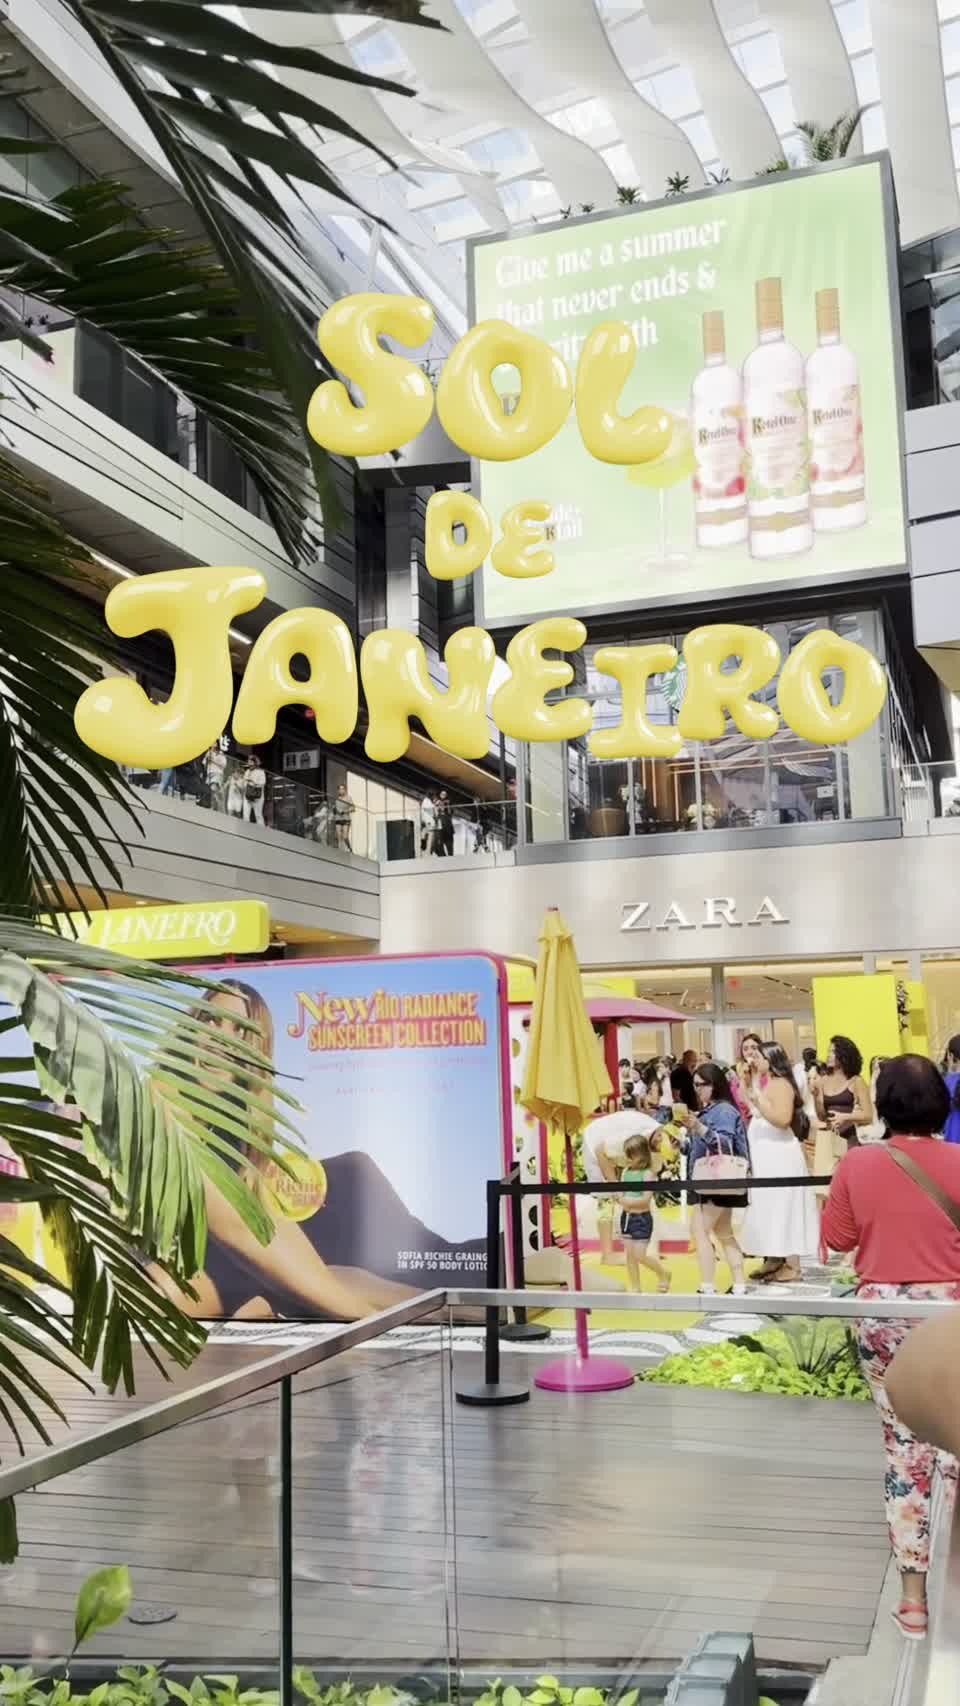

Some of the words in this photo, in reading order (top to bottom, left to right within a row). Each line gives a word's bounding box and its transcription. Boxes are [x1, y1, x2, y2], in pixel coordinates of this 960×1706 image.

[495, 255, 549, 287] Give
[556, 247, 593, 276] me
[599, 242, 614, 266] a
[620, 219, 727, 262] summer
[552, 284, 623, 320] never
[630, 265, 689, 303] ends
[696, 261, 717, 289] &
[619, 896, 791, 932] ZARA
[287, 990, 381, 1037] New
[375, 992, 399, 1019] RIO
[406, 992, 478, 1018] RADIANCE
[308, 1022, 394, 1050] SUNSCREEN
[398, 1019, 486, 1047] COLLECTION
[397, 1251, 422, 1260] SOFIA
[424, 1252, 453, 1261] RICHIE
[398, 1261, 408, 1269] IN
[409, 1261, 424, 1270] SPF
[427, 1261, 437, 1270] 50
[440, 1261, 461, 1270] BODY
